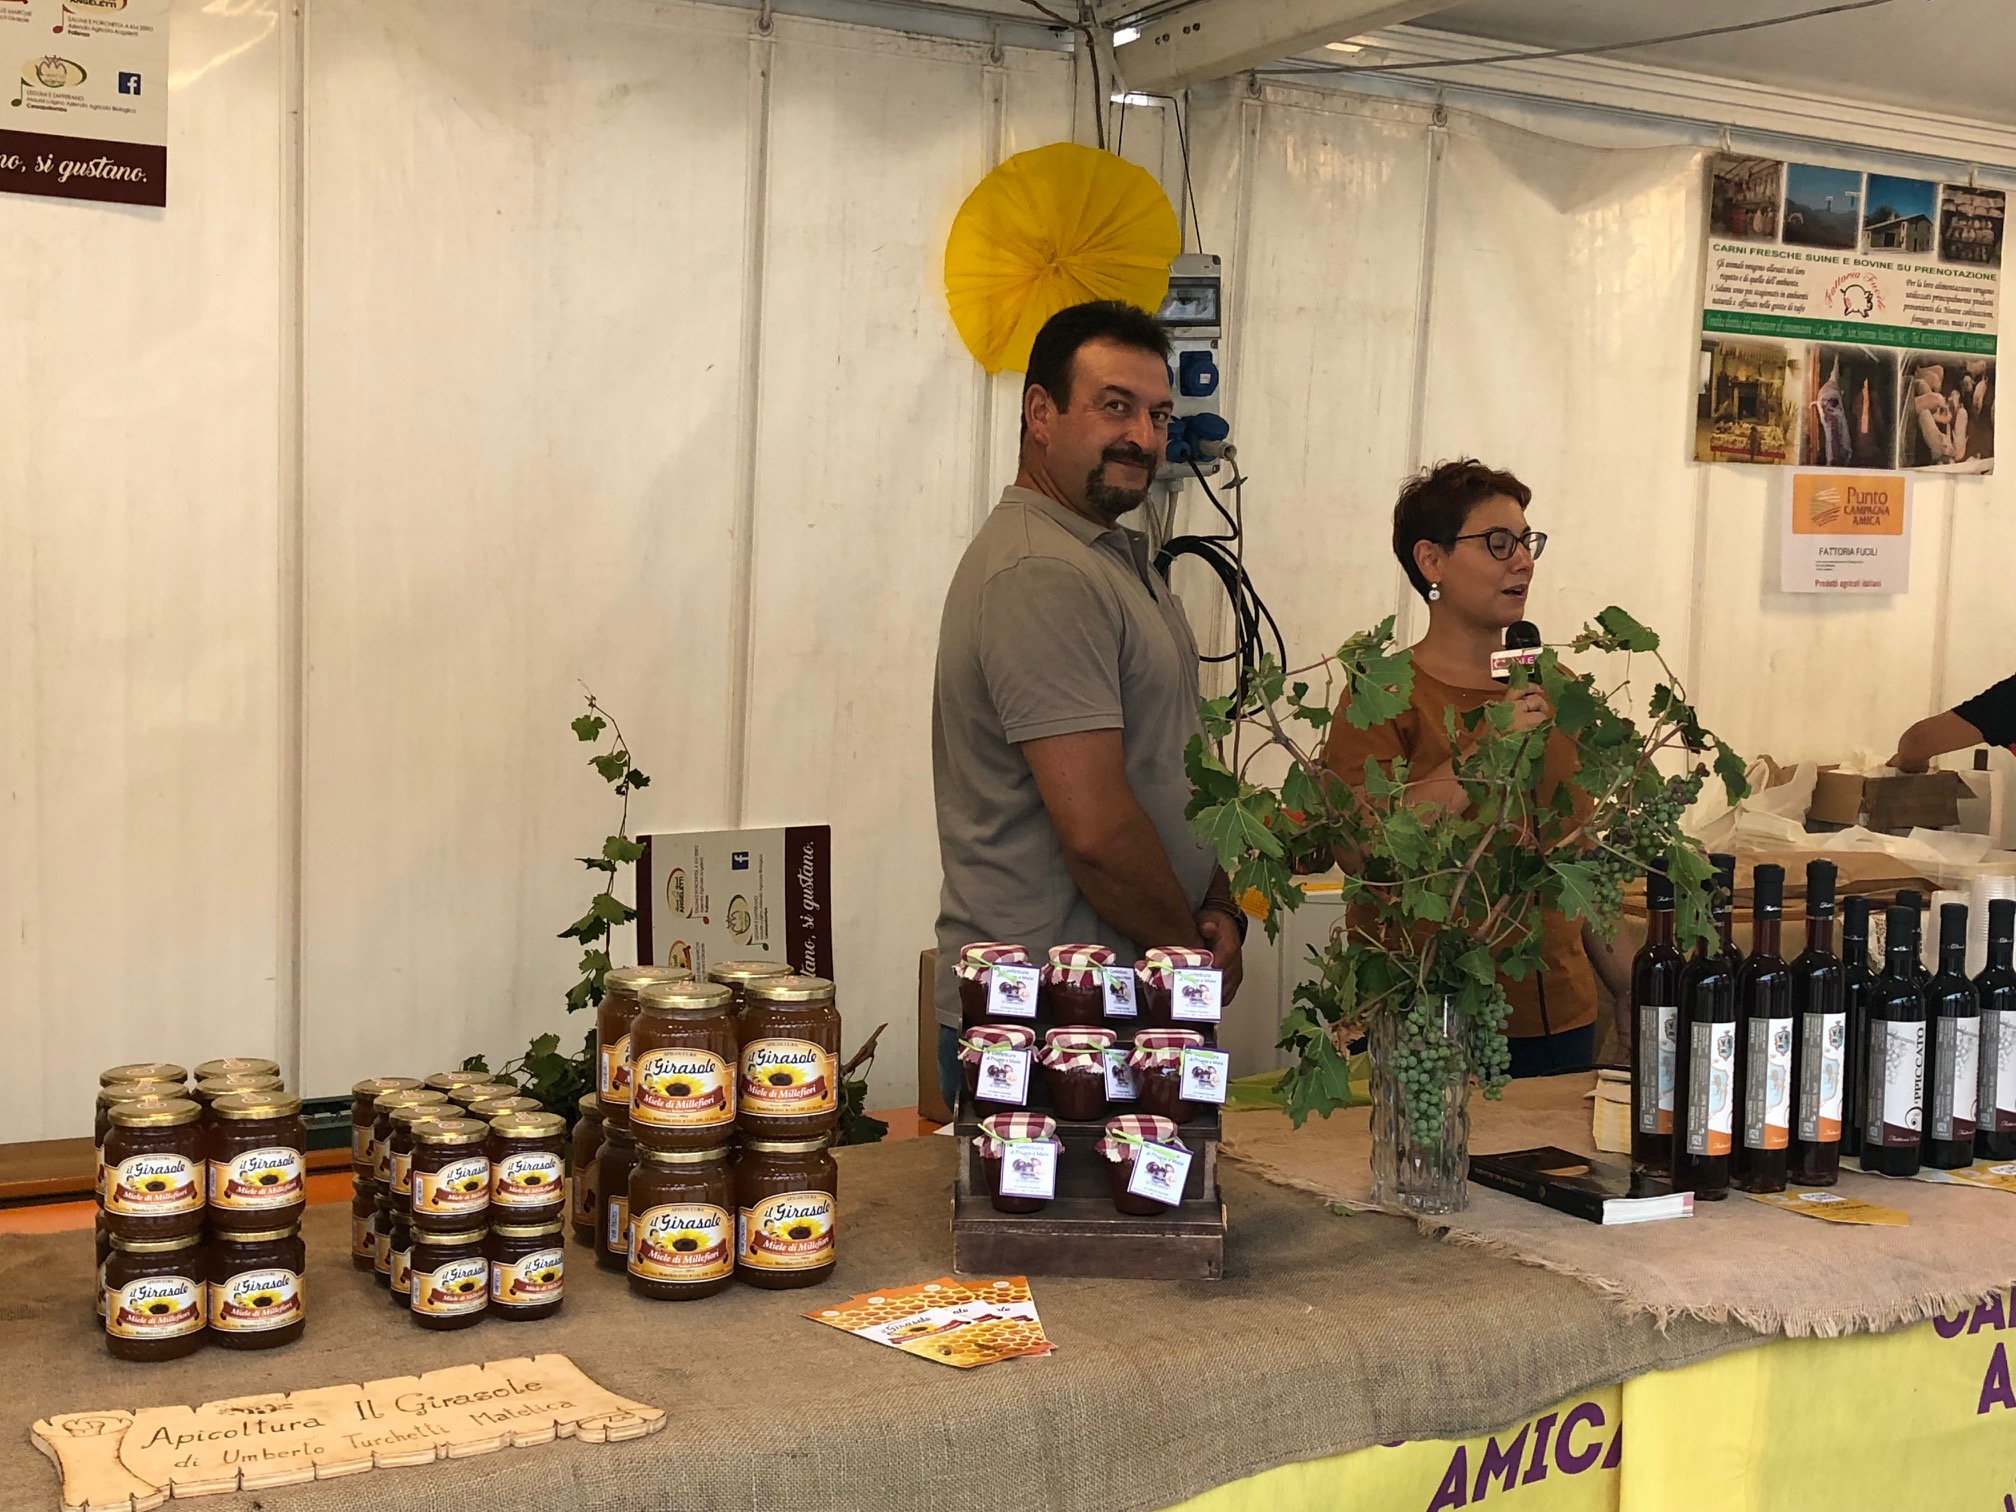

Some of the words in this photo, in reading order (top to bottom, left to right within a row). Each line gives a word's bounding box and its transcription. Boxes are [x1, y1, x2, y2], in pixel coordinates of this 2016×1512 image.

[34, 154, 55, 174] si
[58, 156, 148, 184] gustano.
[1713, 244, 1747, 254] CARNI
[1750, 248, 1802, 260] FRESCHE
[1805, 254, 1840, 264] SUINE
[1853, 258, 1894, 270] BOVINE
[1896, 263, 1912, 272] SU
[1914, 266, 1997, 281] PRENOTAZIONE
[1847, 486, 1888, 506] Punto
[1844, 506, 1890, 516] CAMPAGNA
[1852, 516, 1881, 526] AMICA
[1818, 548, 1854, 556] FATTORIA
[1856, 548, 1878, 556] FUCILI
[1815, 580, 1838, 588] Prodotti
[1840, 580, 1861, 590] agricoli
[1862, 580, 1882, 588] italiani
[797, 841, 820, 911] gustano.
[800, 914, 814, 929] si
[748, 1051, 756, 1062] il
[756, 1048, 817, 1066] Girasole
[644, 1060, 652, 1071] il
[653, 1058, 716, 1076] Girasole
[747, 1085, 767, 1096] Miele
[768, 1089, 777, 1098] di
[778, 1084, 816, 1098] Millefiori
[644, 1094, 664, 1106] Miele
[666, 1099, 674, 1108] di
[675, 1094, 714, 1109] Millefiori
[126, 1166, 133, 1174] il
[134, 1160, 185, 1176] Girasole
[240, 1160, 246, 1170] il
[248, 1153, 294, 1172] Girasole
[508, 1162, 514, 1170] il
[514, 1158, 556, 1172] Girasole
[123, 1191, 144, 1200] Miele
[154, 1190, 188, 1200] Millefiori
[236, 1186, 257, 1195] Miele
[268, 1181, 297, 1195] Millefiori
[764, 1206, 773, 1218] il
[774, 1200, 830, 1221] Girasole
[650, 1216, 659, 1227] il
[659, 1212, 720, 1231] Girasole
[762, 1240, 786, 1251] Miele
[788, 1242, 796, 1252] di
[798, 1234, 829, 1252] Millefiori
[648, 1250, 670, 1262] Miele
[672, 1254, 681, 1264] di
[682, 1248, 720, 1264] Millefiori
[525, 1262, 532, 1270] il
[130, 1288, 136, 1297] il
[138, 1282, 188, 1300] Girasole
[234, 1283, 240, 1292] il
[241, 1274, 290, 1294] Girasole
[126, 1314, 147, 1324] Miele
[158, 1310, 190, 1324] Millefiori
[231, 1308, 251, 1316] Miele
[262, 1302, 292, 1316] Millefiori
[886, 1316, 931, 1332] Girasole
[140, 1417, 326, 1450] Apicoltura
[354, 1398, 384, 1422] Il
[395, 1378, 543, 1416] Girasole
[174, 1454, 199, 1468] di
[223, 1442, 326, 1464] Umberto
[342, 1422, 450, 1450] Turchetti
[469, 1400, 578, 1426] Matelica
